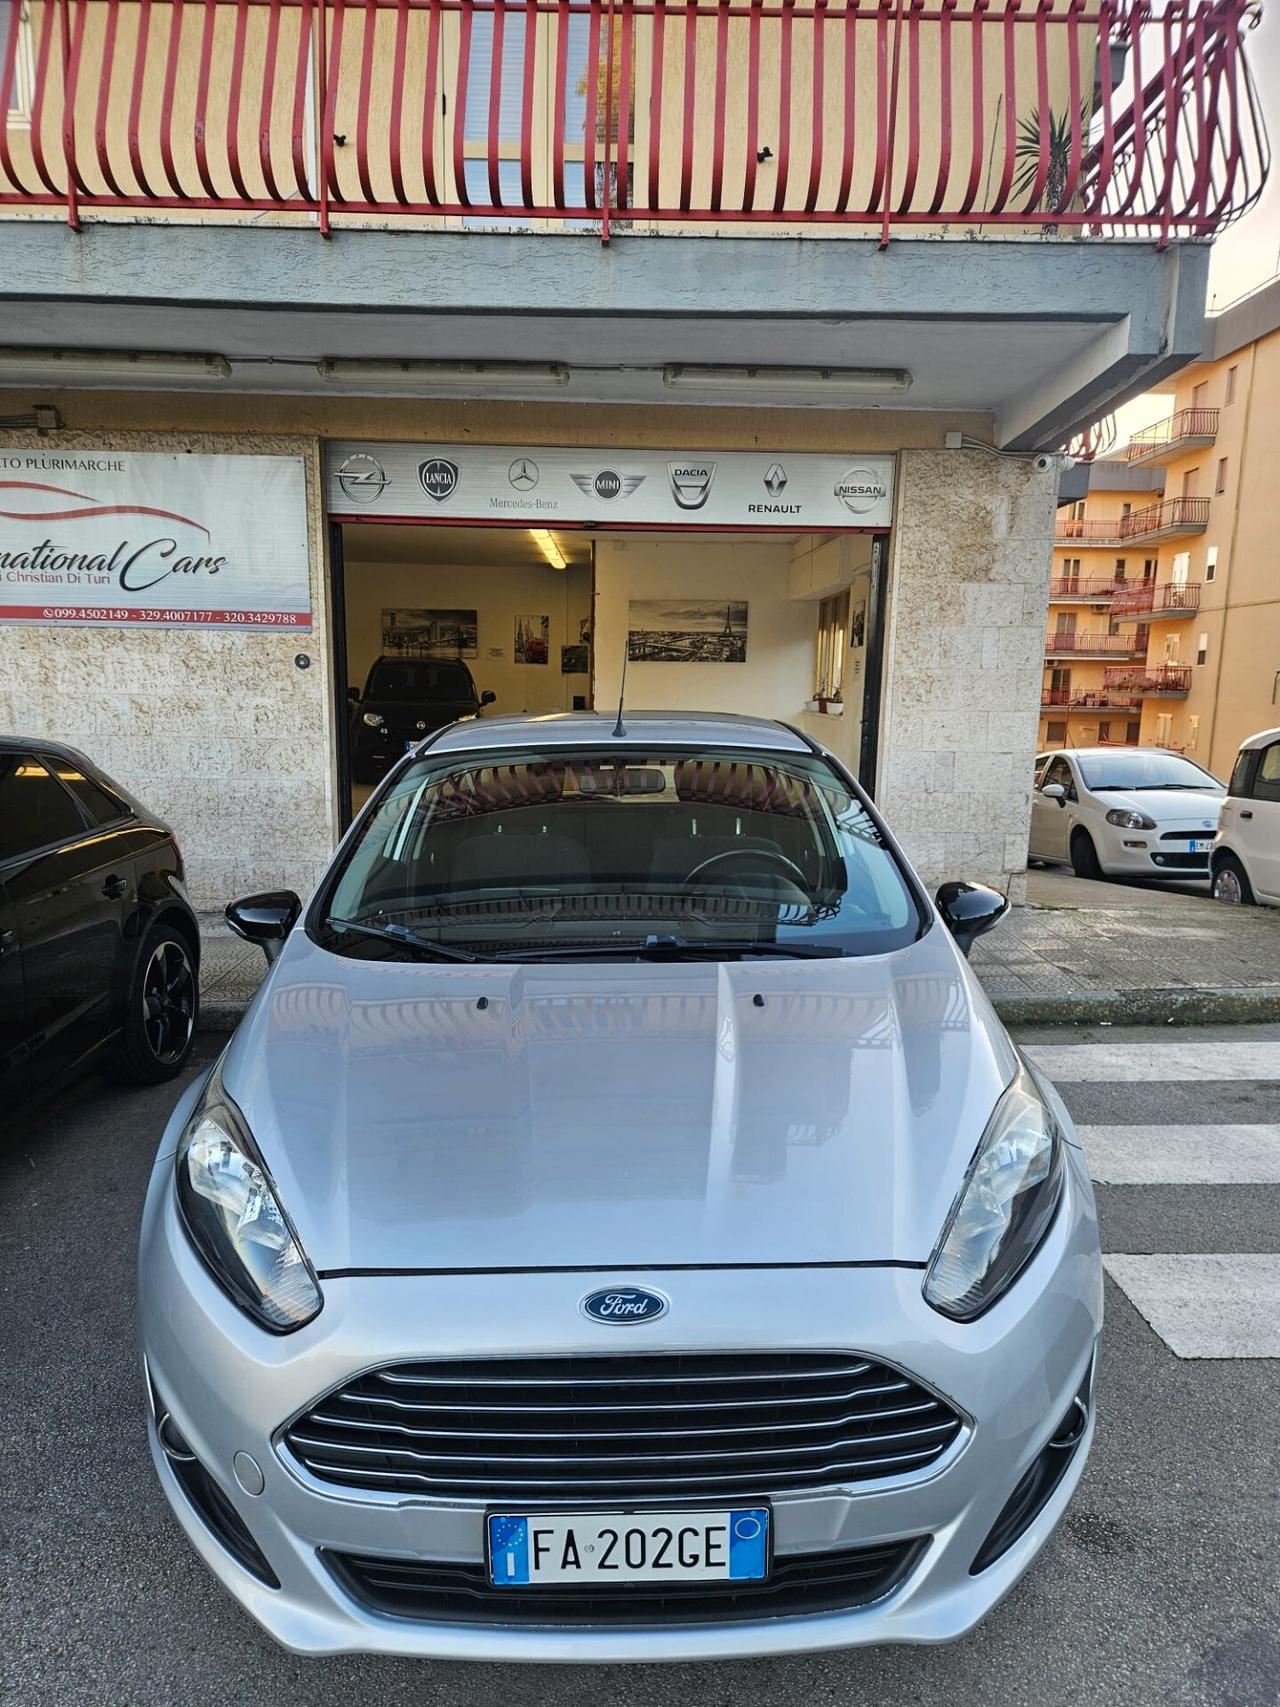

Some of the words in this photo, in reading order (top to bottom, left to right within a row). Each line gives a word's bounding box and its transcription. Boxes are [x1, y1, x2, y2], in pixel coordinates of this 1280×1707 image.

[0, 457, 21, 469] TO
[26, 457, 126, 472] PLURIMARCHE
[426, 472, 452, 485] LANCIA
[674, 468, 708, 477] DACIA
[596, 480, 620, 491] MINI
[839, 485, 882, 496] NISSAN
[489, 498, 558, 510] Mercedes-Benz
[748, 504, 802, 514] RENAULT
[119, 538, 227, 592] Cars
[6, 571, 63, 584] Christian
[67, 573, 81, 584] Di
[85, 573, 110, 585] Turi
[54, 609, 128, 620] 099.4502149
[139, 610, 212, 622] 329.4007177
[223, 611, 297, 624] 320.3429788
[600, 1293, 647, 1316] Ford
